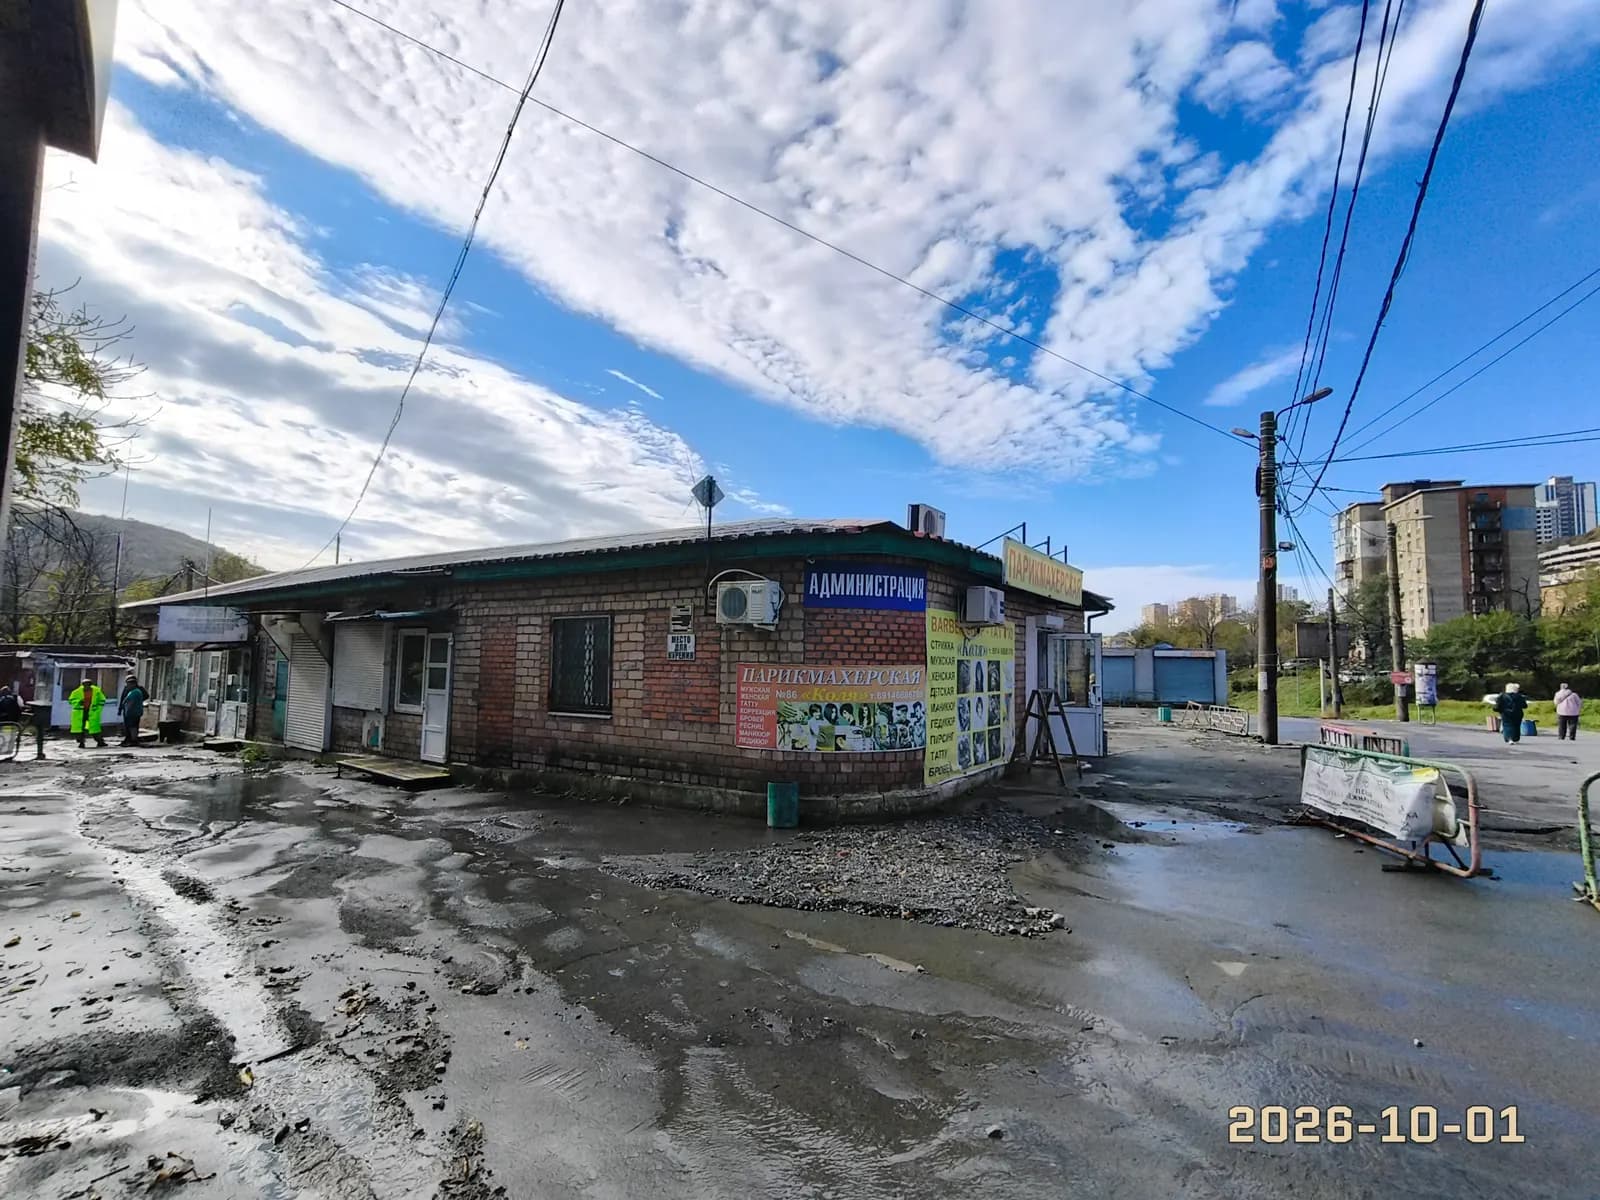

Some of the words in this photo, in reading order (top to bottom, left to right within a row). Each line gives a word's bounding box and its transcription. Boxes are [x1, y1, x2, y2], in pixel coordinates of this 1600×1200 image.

[1009, 548, 1081, 599] ПАРИКМАХЕРСКАЯ
[809, 573, 924, 602] АДМИНИСТРАЦИЯ
[671, 635, 691, 644] МЕСТО
[930, 655, 956, 666] МУЖСКАЯ
[742, 667, 922, 686] ПАРИКМАХЕРСКАЯ
[931, 671, 956, 681] ЖЕНСКАЯ
[776, 689, 798, 699] №86
[930, 687, 955, 699] ДЕТСКАЯ
[740, 707, 776, 716] КОРРЕКЦИЯ
[739, 729, 771, 738] МАНИКЮР
[738, 737, 769, 745] ПЕДИКЮР
